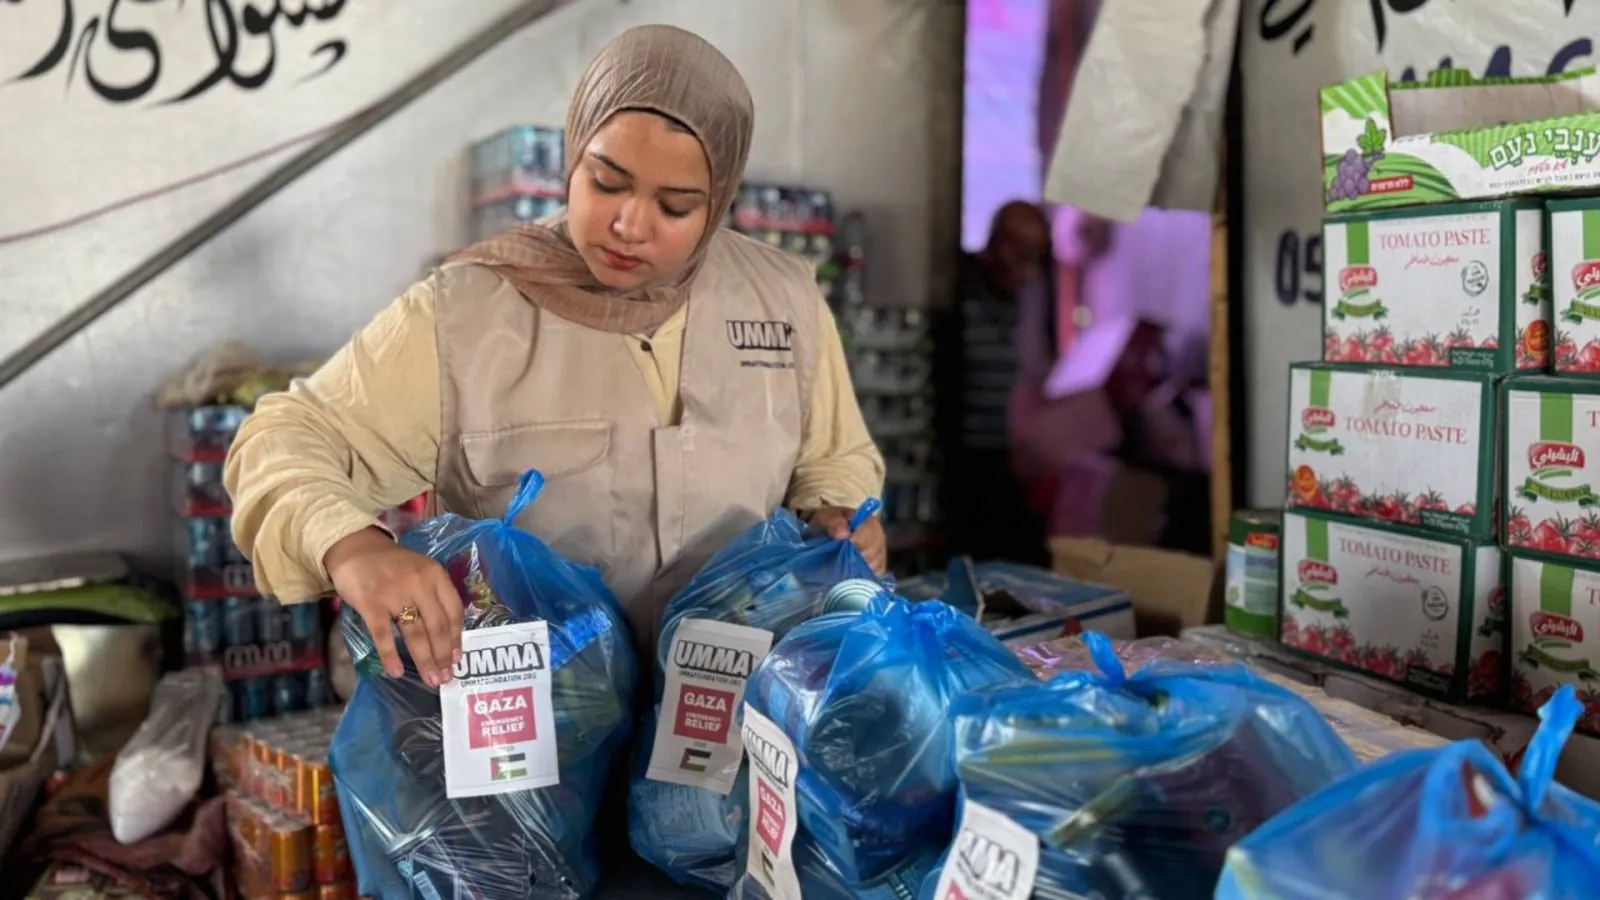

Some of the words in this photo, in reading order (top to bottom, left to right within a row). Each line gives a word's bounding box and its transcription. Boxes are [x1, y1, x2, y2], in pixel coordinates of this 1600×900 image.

[1379, 232, 1441, 250] TOMATO
[1445, 228, 1490, 246] PASTE
[1345, 416, 1411, 438] TOMATO
[1416, 423, 1468, 445] PASTE
[1339, 537, 1401, 563] TOMATO
[1405, 552, 1452, 576] PASTE
[453, 642, 545, 680] UMMA
[674, 639, 752, 679] UMMA
[474, 695, 528, 715] GAZA
[684, 692, 727, 712] GAZA
[482, 722, 525, 738] RELIEF
[684, 718, 722, 732] RELIEF
